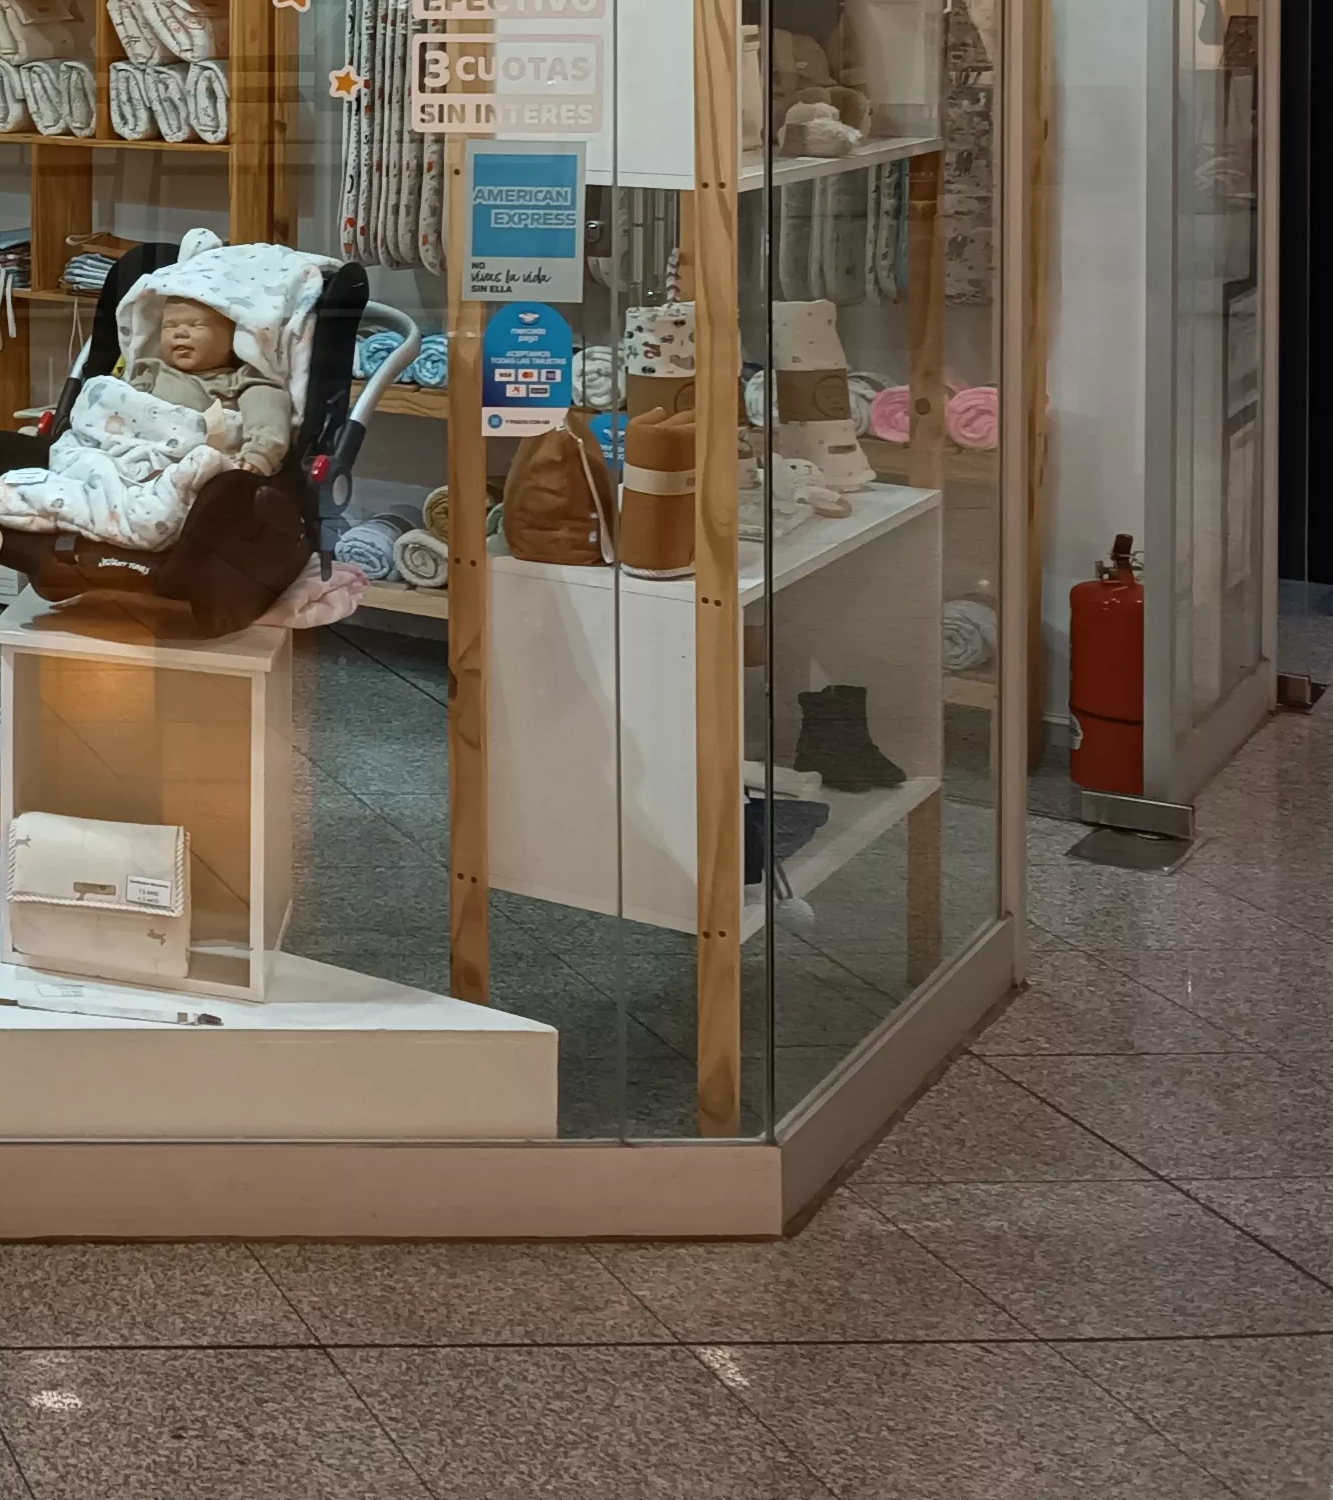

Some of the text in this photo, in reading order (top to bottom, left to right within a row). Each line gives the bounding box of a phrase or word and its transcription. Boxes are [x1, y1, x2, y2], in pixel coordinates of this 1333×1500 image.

[424, 50, 590, 87] 3 CUOTAS
[420, 103, 593, 125] SIN INTERES
[473, 187, 570, 204] AMERICAN
[492, 211, 576, 227] EXPRESS
[471, 262, 485, 270] NO
[522, 266, 552, 284] vida
[471, 285, 513, 293] SIN ELLA
